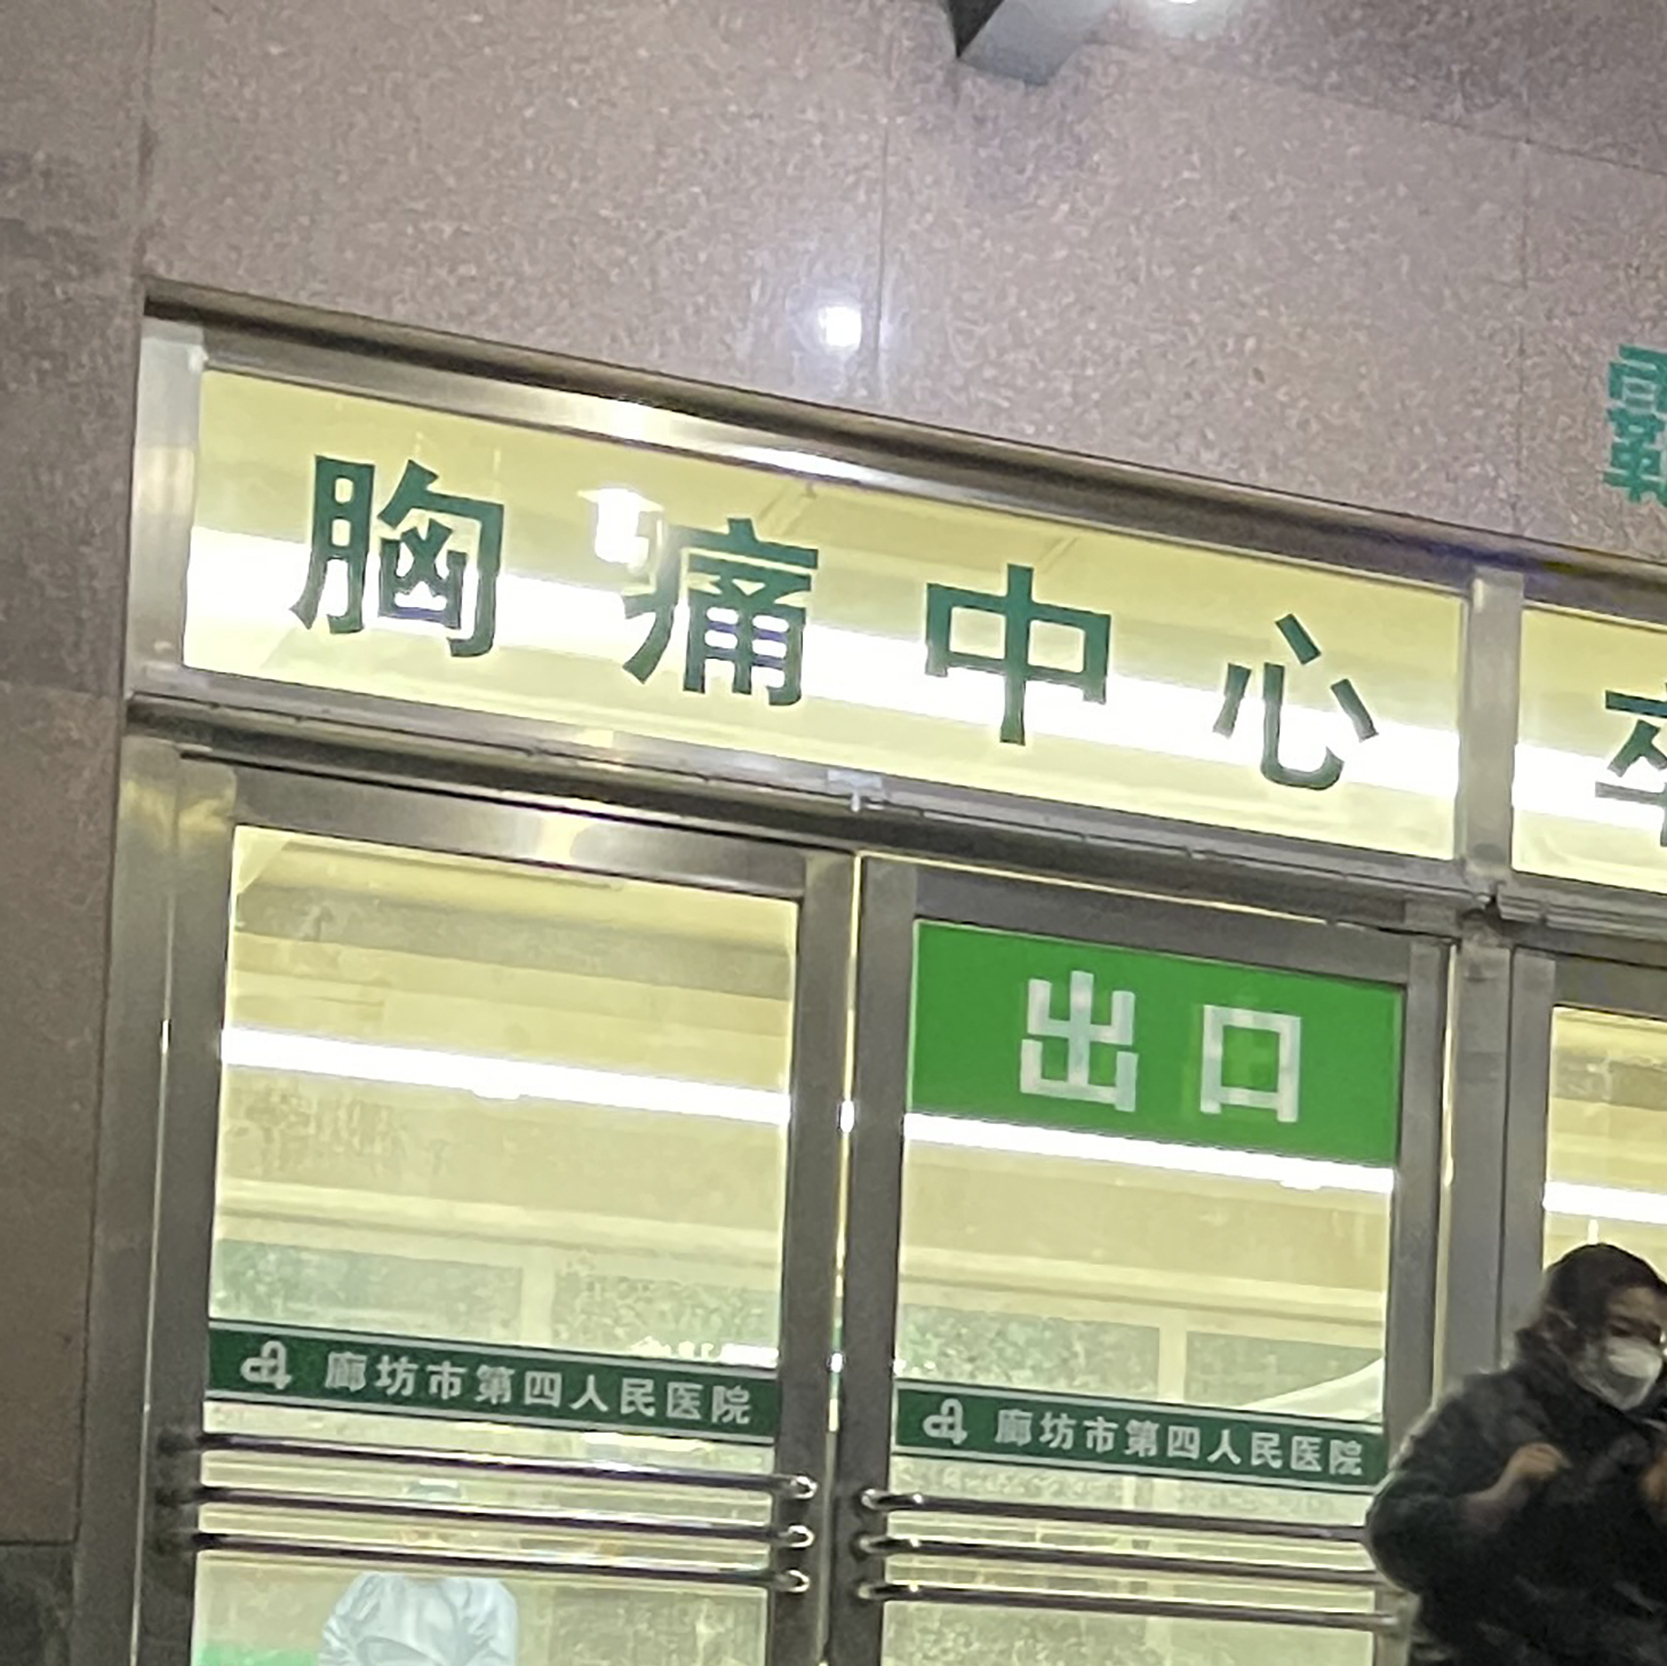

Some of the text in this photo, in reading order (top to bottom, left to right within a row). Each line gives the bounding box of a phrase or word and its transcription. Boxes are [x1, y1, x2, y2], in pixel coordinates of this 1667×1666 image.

[293, 455, 1377, 791] 胸痛中心
[1019, 970, 1302, 1122] 出口
[324, 1350, 752, 1425] 廊坊市第四人民医院
[995, 1410, 1364, 1476] 廊坊市第四人民医院
